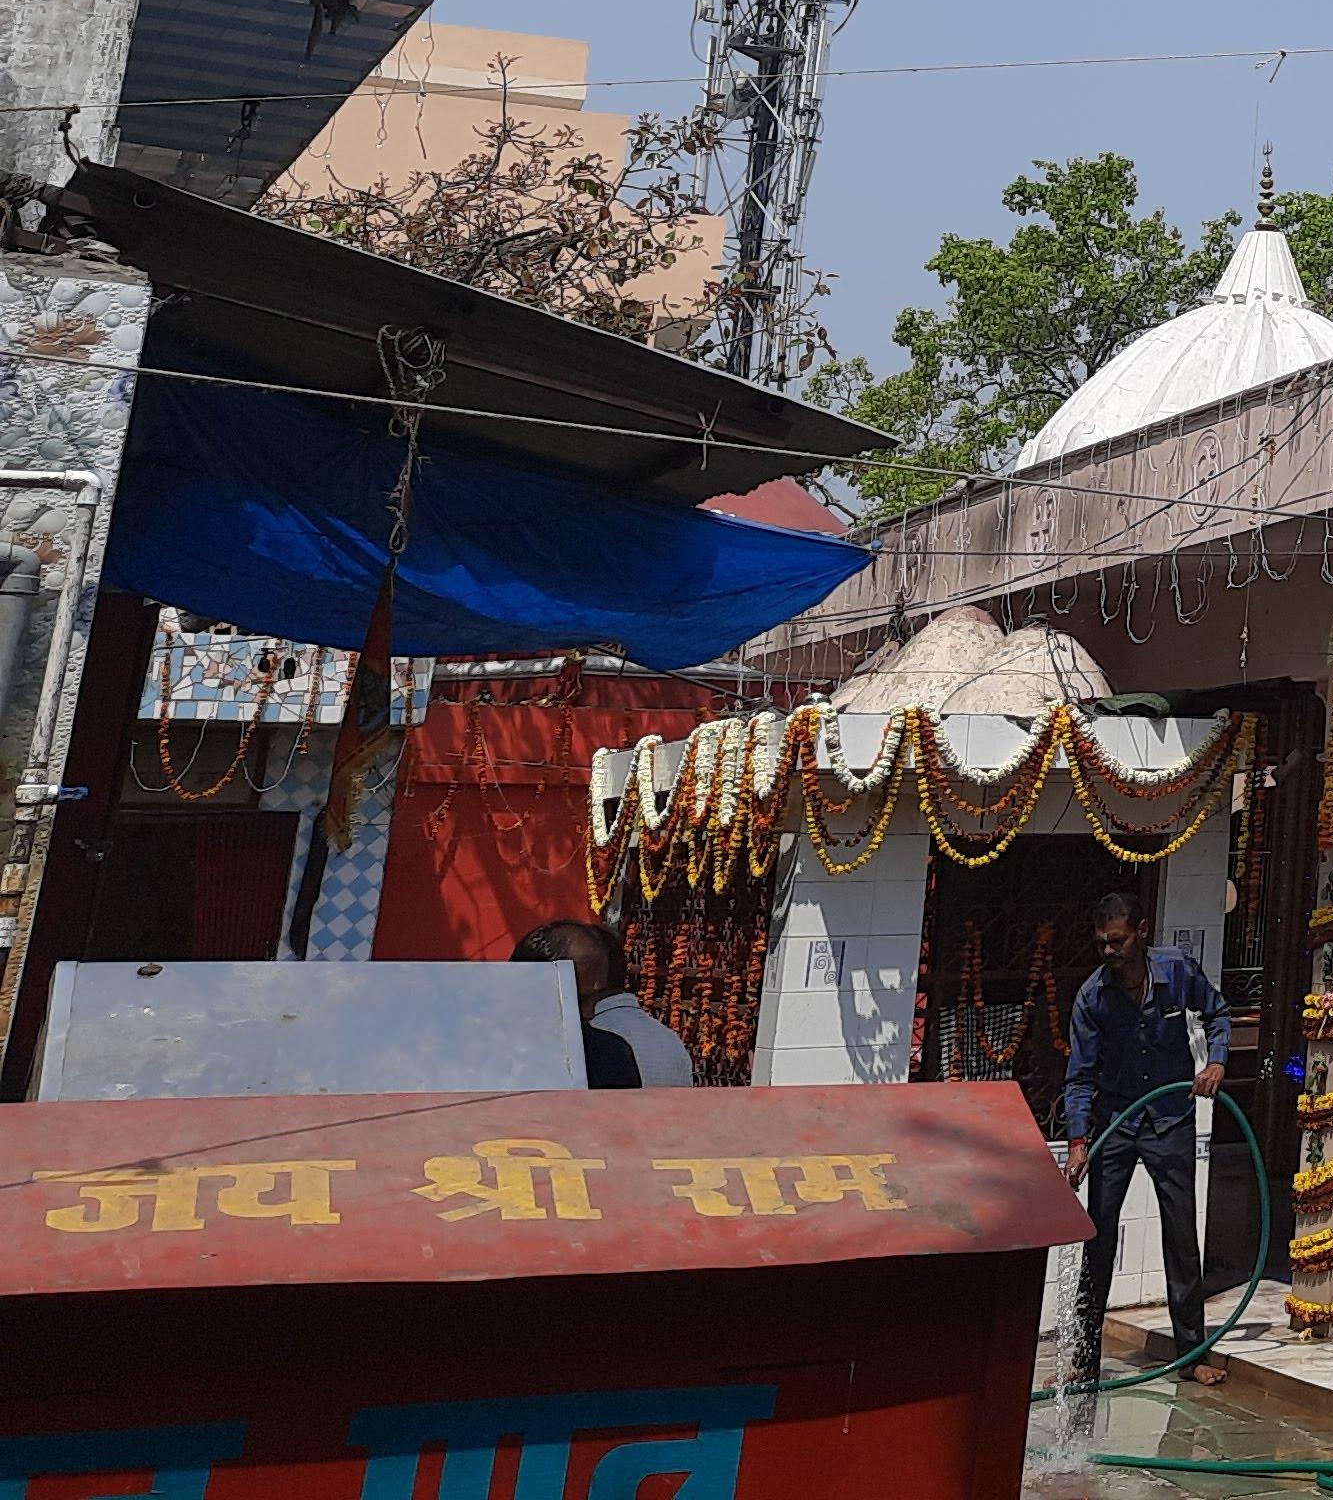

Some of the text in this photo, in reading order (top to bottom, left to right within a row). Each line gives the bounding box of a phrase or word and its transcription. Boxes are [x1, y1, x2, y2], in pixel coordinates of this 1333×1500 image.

[32, 1138, 908, 1232] जय श्री राम
